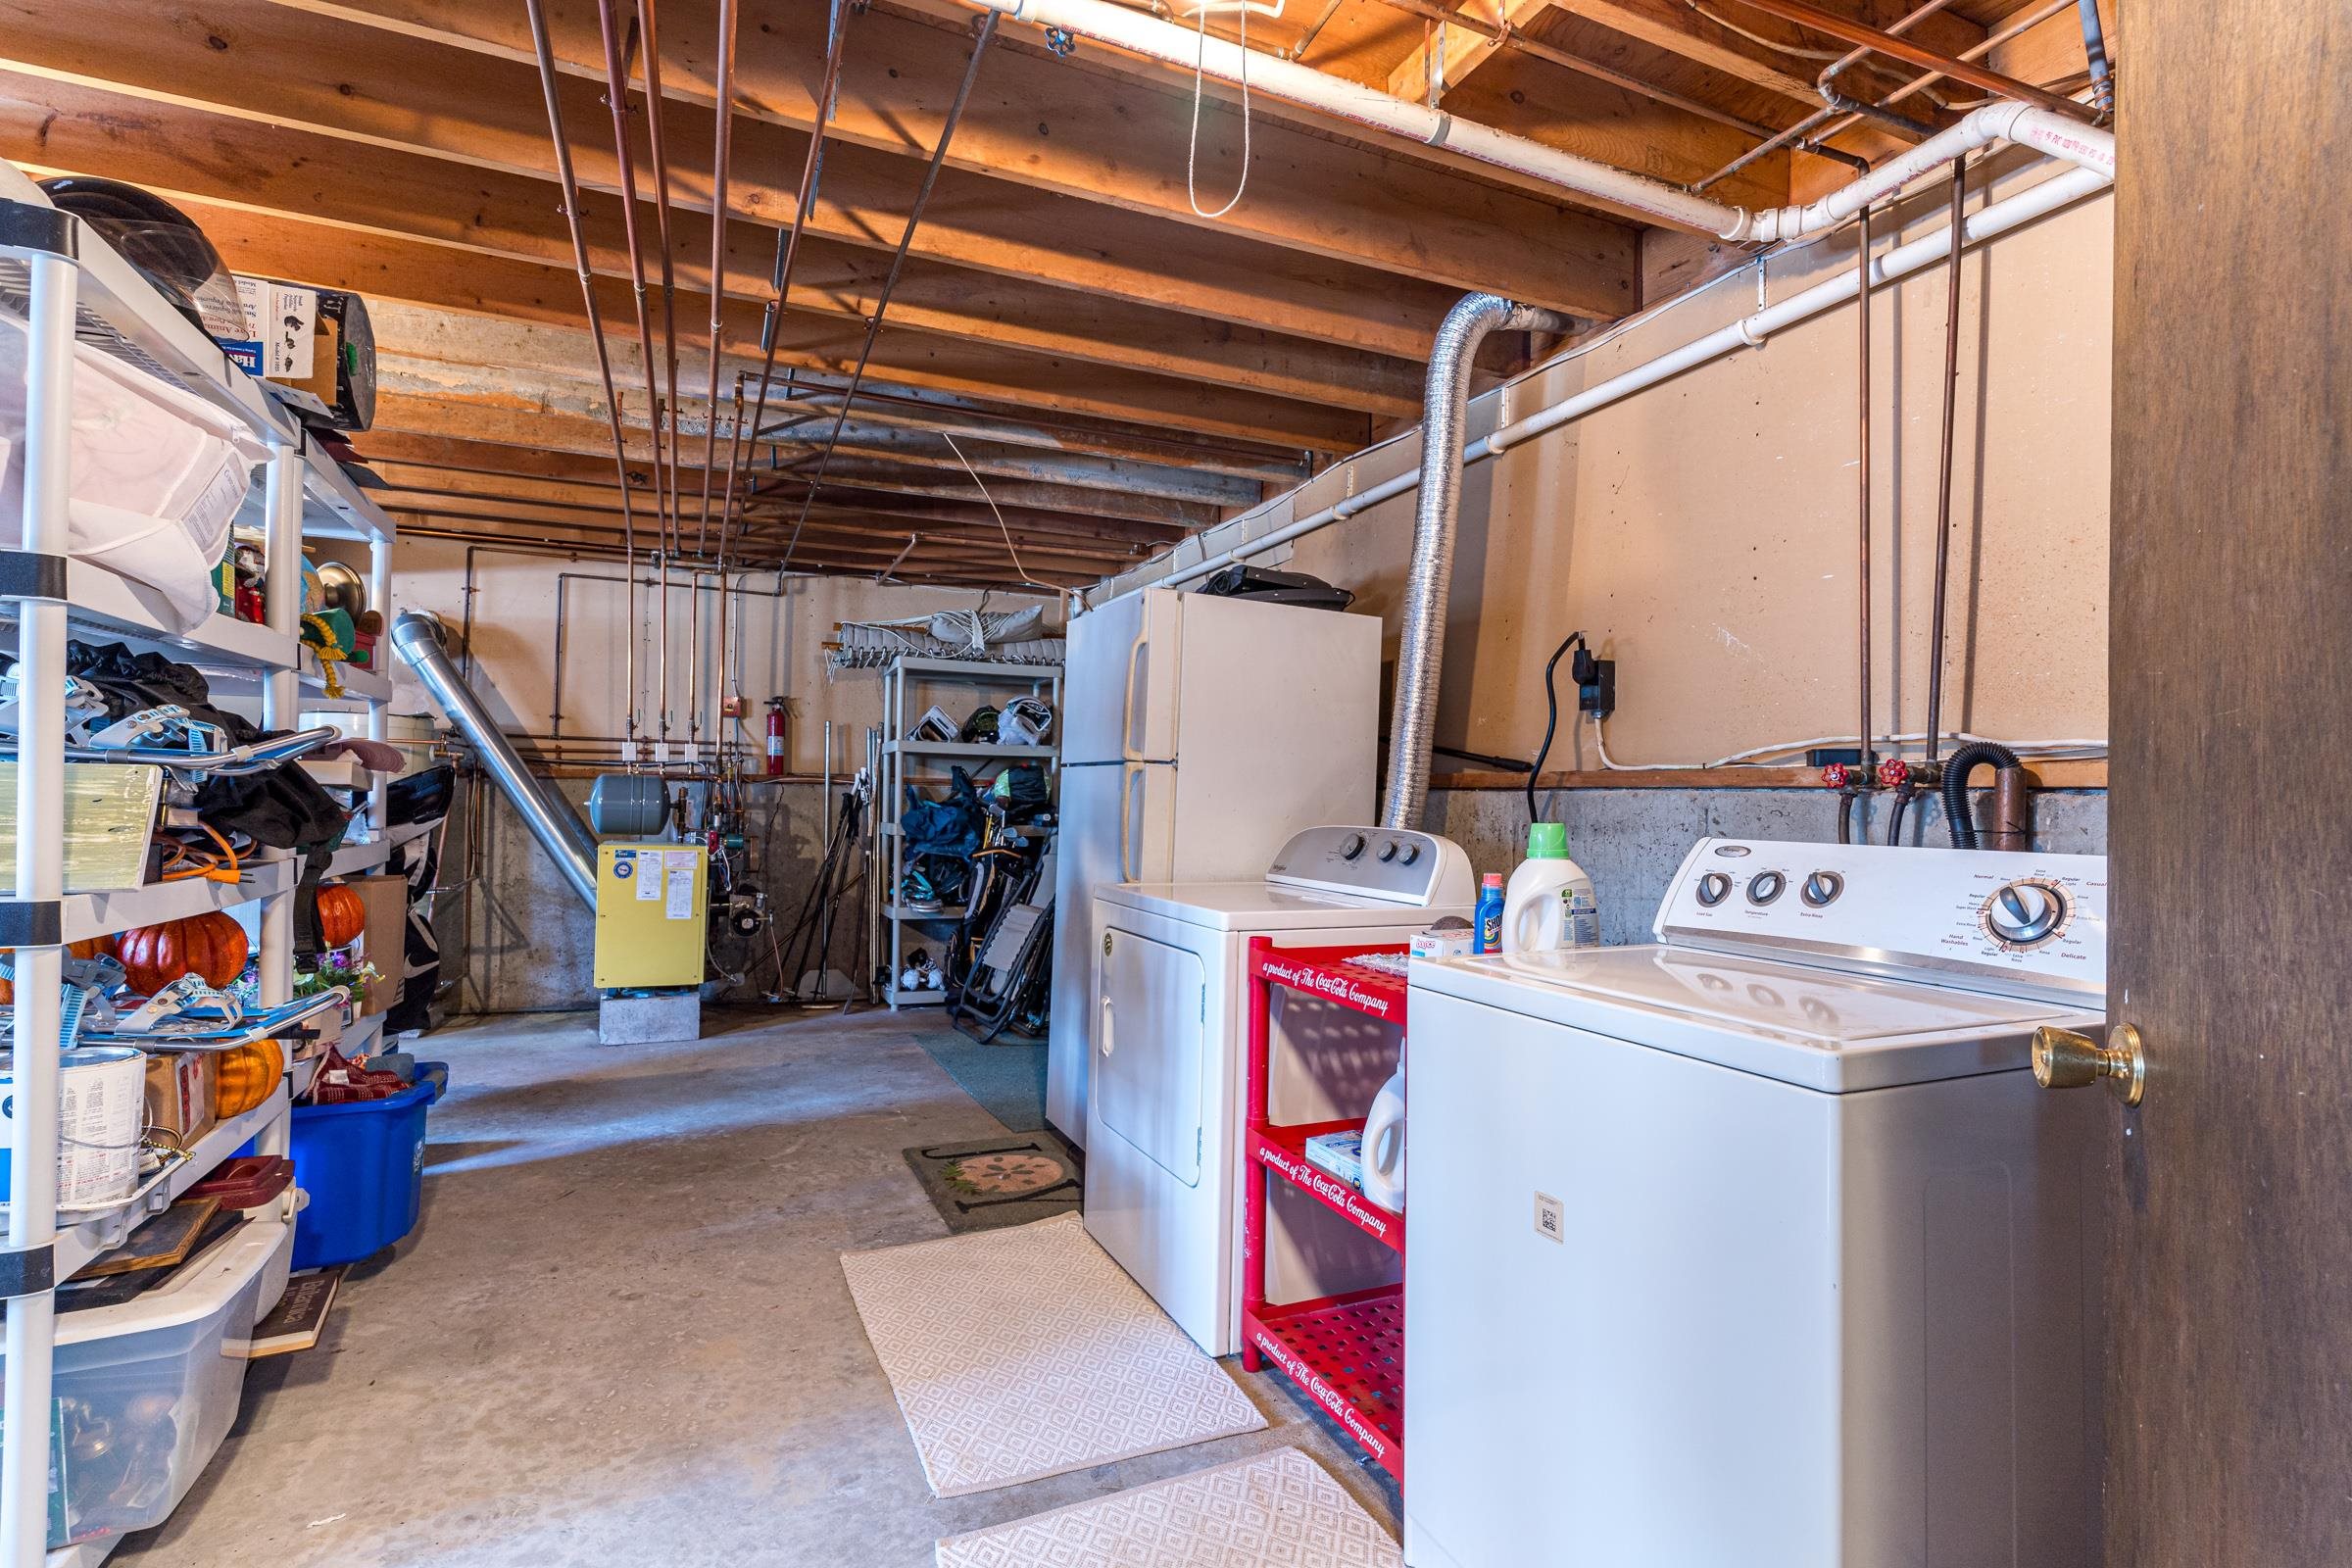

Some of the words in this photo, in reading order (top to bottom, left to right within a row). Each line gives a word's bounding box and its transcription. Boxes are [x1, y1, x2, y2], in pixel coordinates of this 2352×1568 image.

[1940, 938, 1969, 947] Washables
[2061, 952, 2086, 960] Delicate
[1262, 962, 1268, 971] a
[1266, 962, 1293, 980] product
[1292, 969, 1302, 987] of
[1300, 967, 1314, 988] The
[1348, 983, 1389, 1016] Company
[1259, 1147, 1265, 1155] a
[1263, 1150, 1290, 1171] product
[1289, 1164, 1299, 1181] of
[1298, 1164, 1312, 1187] The
[1347, 1195, 1387, 1238] Company
[1256, 1332, 1262, 1342] a
[1260, 1336, 1288, 1364] product
[1286, 1360, 1297, 1376] of
[1295, 1362, 1310, 1387] The
[1344, 1407, 1386, 1459] Company
